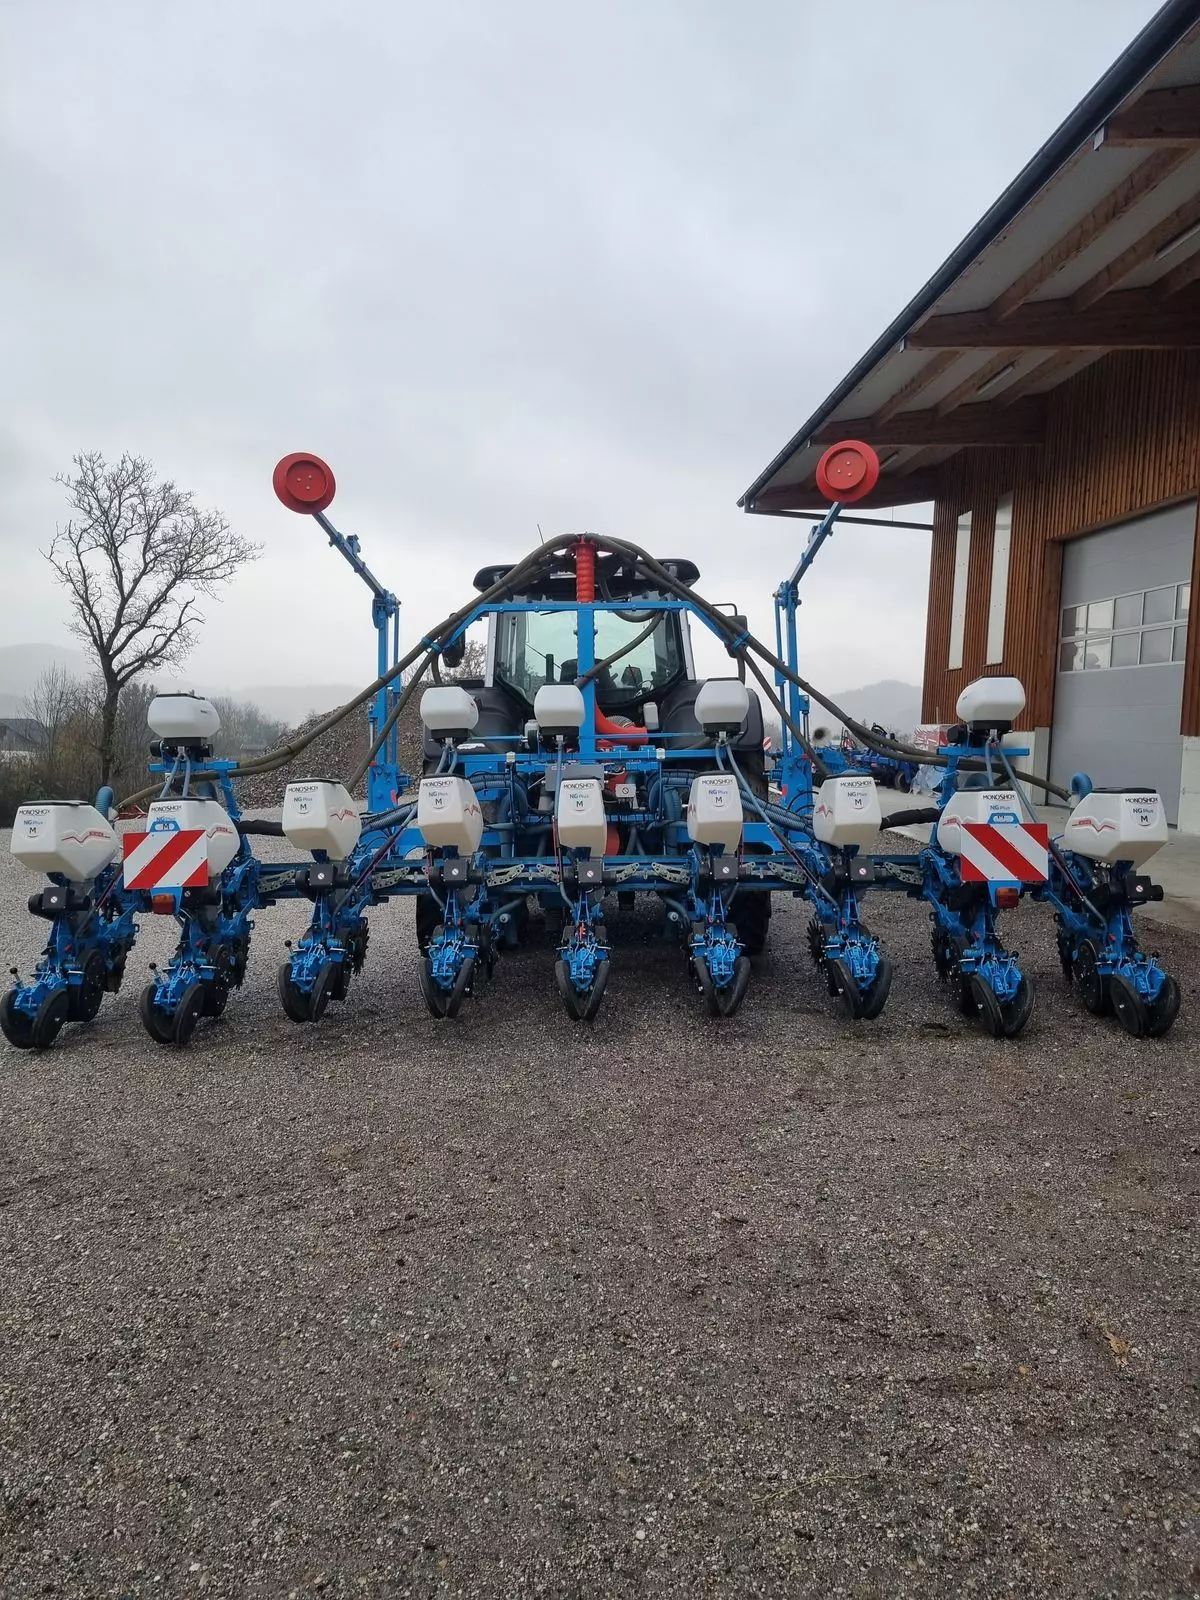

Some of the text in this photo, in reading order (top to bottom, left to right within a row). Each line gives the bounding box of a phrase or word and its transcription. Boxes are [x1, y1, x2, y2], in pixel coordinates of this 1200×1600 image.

[288, 785, 319, 793] MONOSHOX
[151, 804, 182, 812] MONOSHOX
[1140, 815, 1148, 823] M
